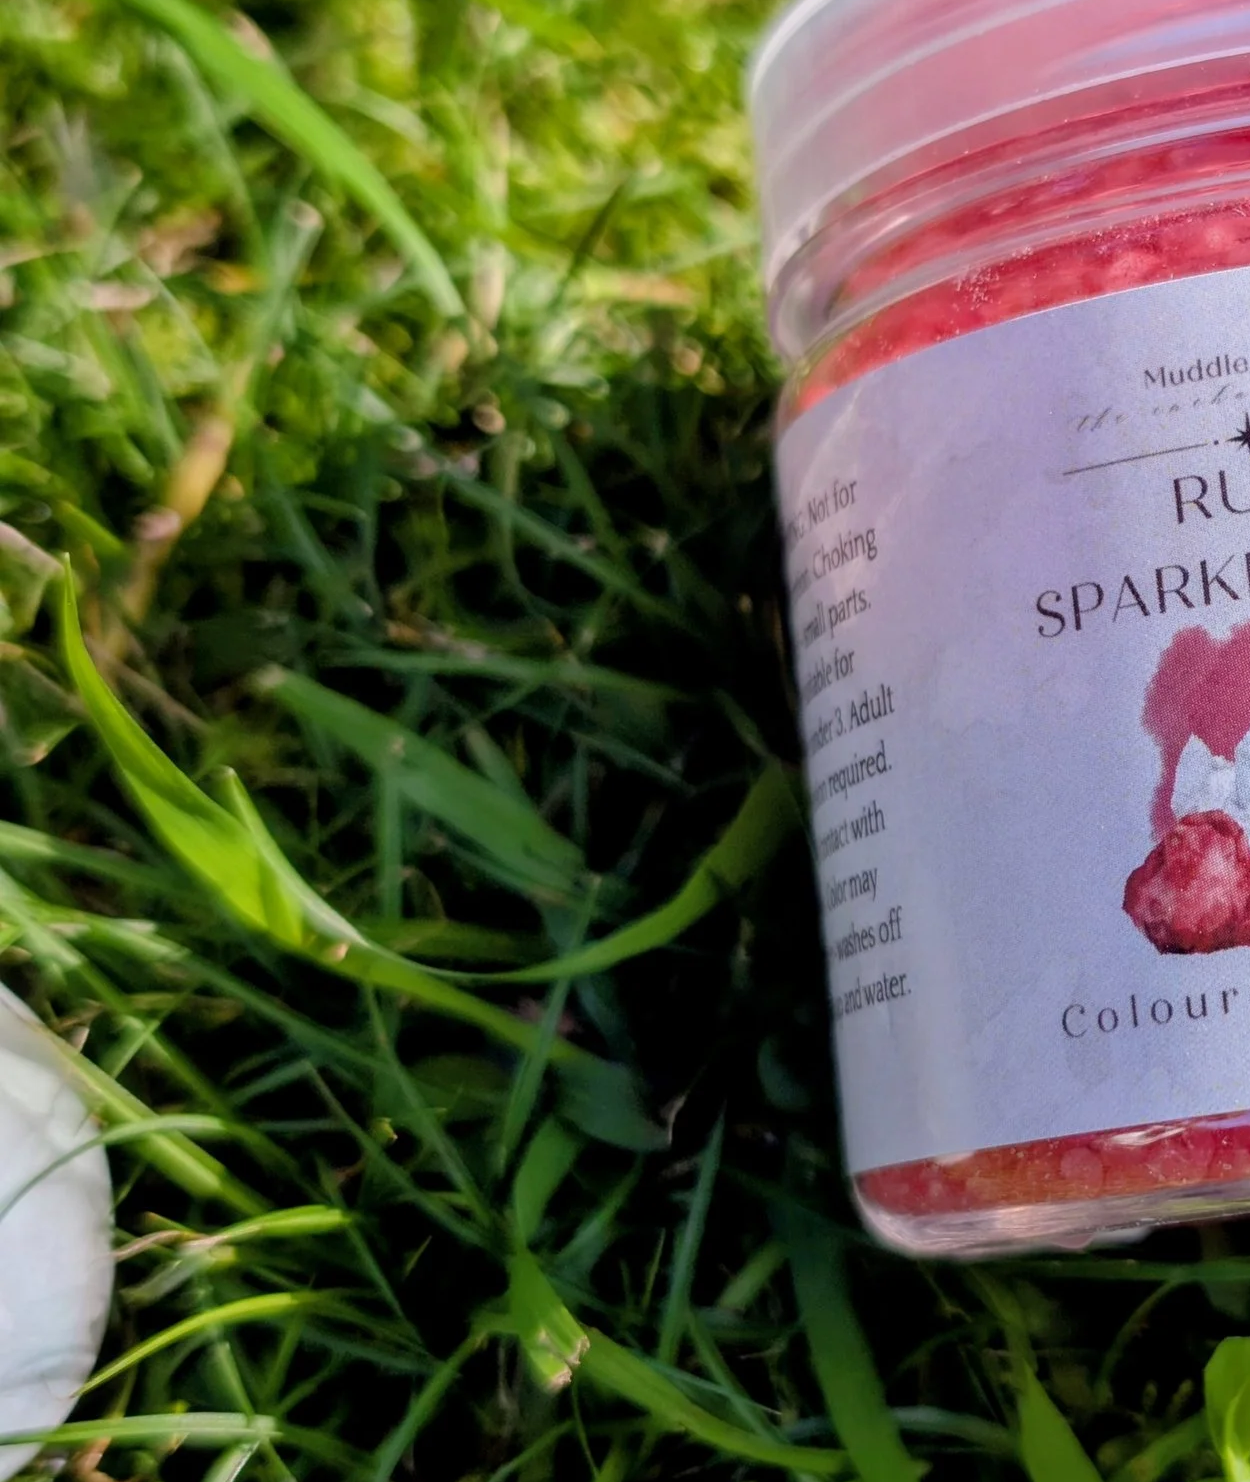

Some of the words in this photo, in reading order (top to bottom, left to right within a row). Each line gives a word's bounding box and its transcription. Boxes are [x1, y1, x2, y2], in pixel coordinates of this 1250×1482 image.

[1144, 352, 1249, 389] Muddle
[807, 489, 831, 531] Not
[832, 479, 858, 513] for
[812, 527, 878, 579] Choking
[828, 587, 872, 638] parts.
[833, 647, 856, 680] for
[849, 682, 896, 733] Adult
[828, 739, 893, 800] required.
[850, 800, 886, 841] with
[849, 867, 878, 903] may
[836, 920, 876, 964] washes
[878, 905, 903, 945] off
[862, 972, 912, 1006] water.
